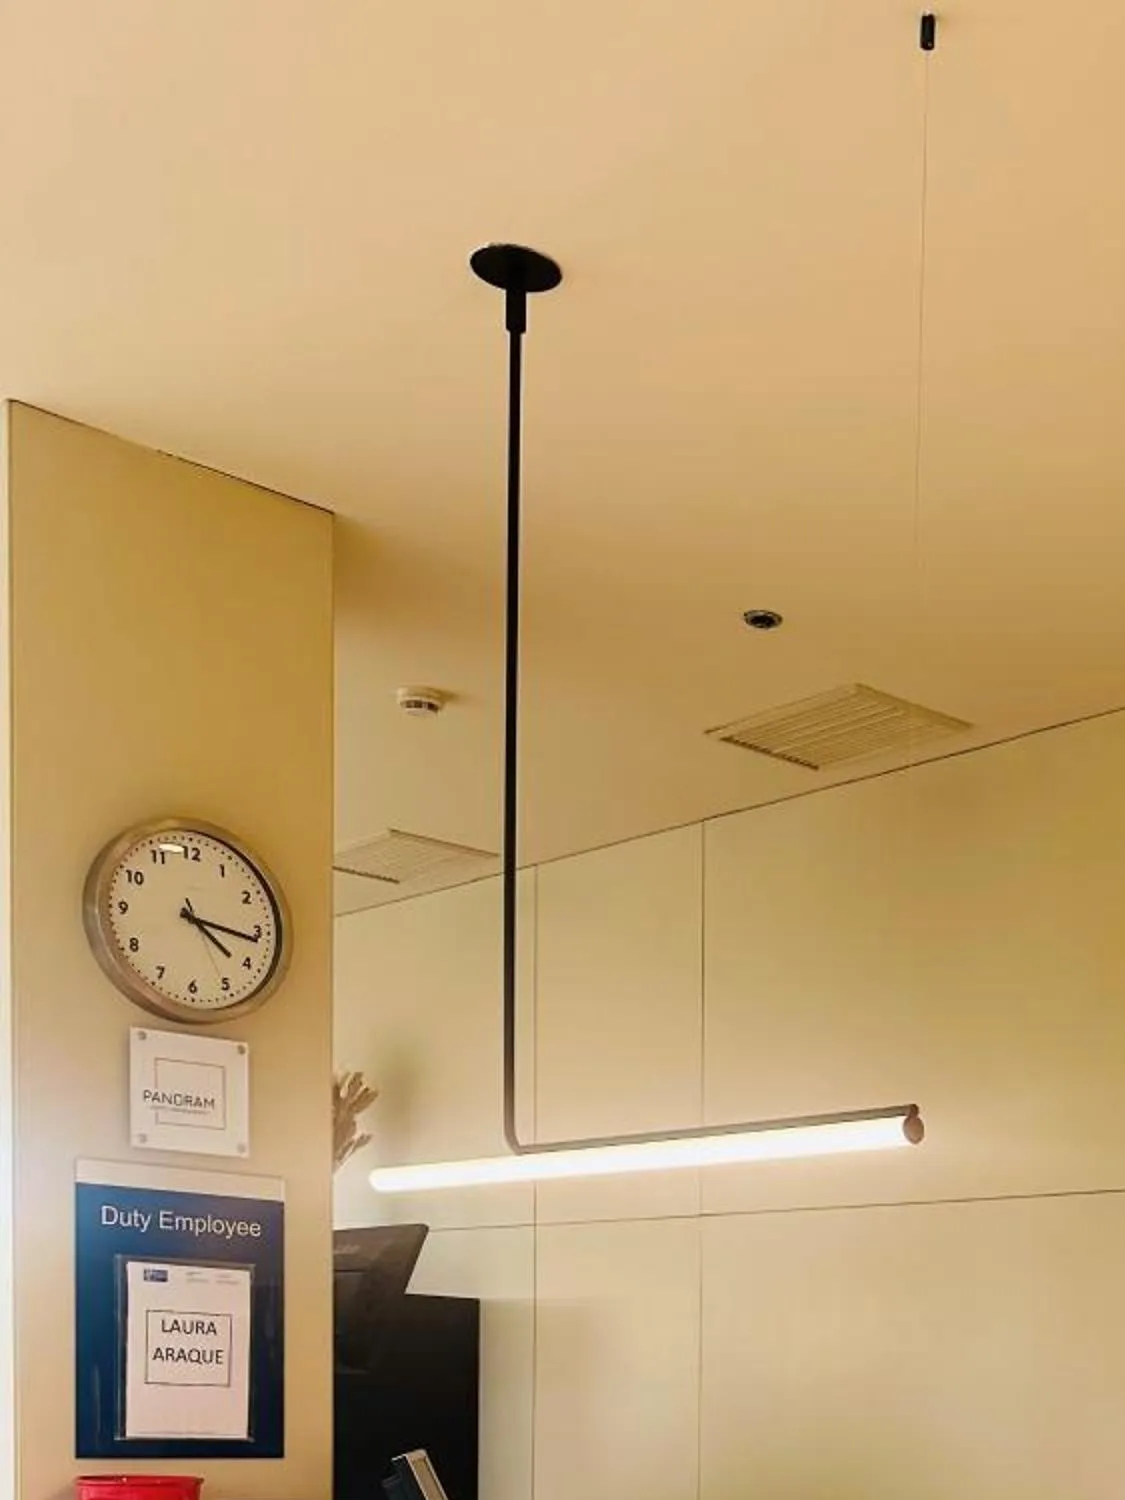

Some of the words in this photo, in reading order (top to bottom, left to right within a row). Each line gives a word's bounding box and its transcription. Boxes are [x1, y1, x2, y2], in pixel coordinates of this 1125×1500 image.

[151, 849, 166, 864] 11
[182, 846, 201, 862] 12
[126, 869, 144, 886] 10
[242, 891, 252, 904] 2
[118, 901, 129, 915] 9
[253, 925, 262, 939] 3
[129, 937, 139, 952] 8
[242, 956, 252, 970] 4
[155, 966, 165, 979] 7
[188, 980, 198, 994] 6
[221, 978, 230, 991] 5
[101, 1205, 151, 1232] Duty
[159, 1209, 261, 1239] Employee
[161, 1319, 217, 1335] LAURA
[152, 1347, 224, 1365] ARAQUE
